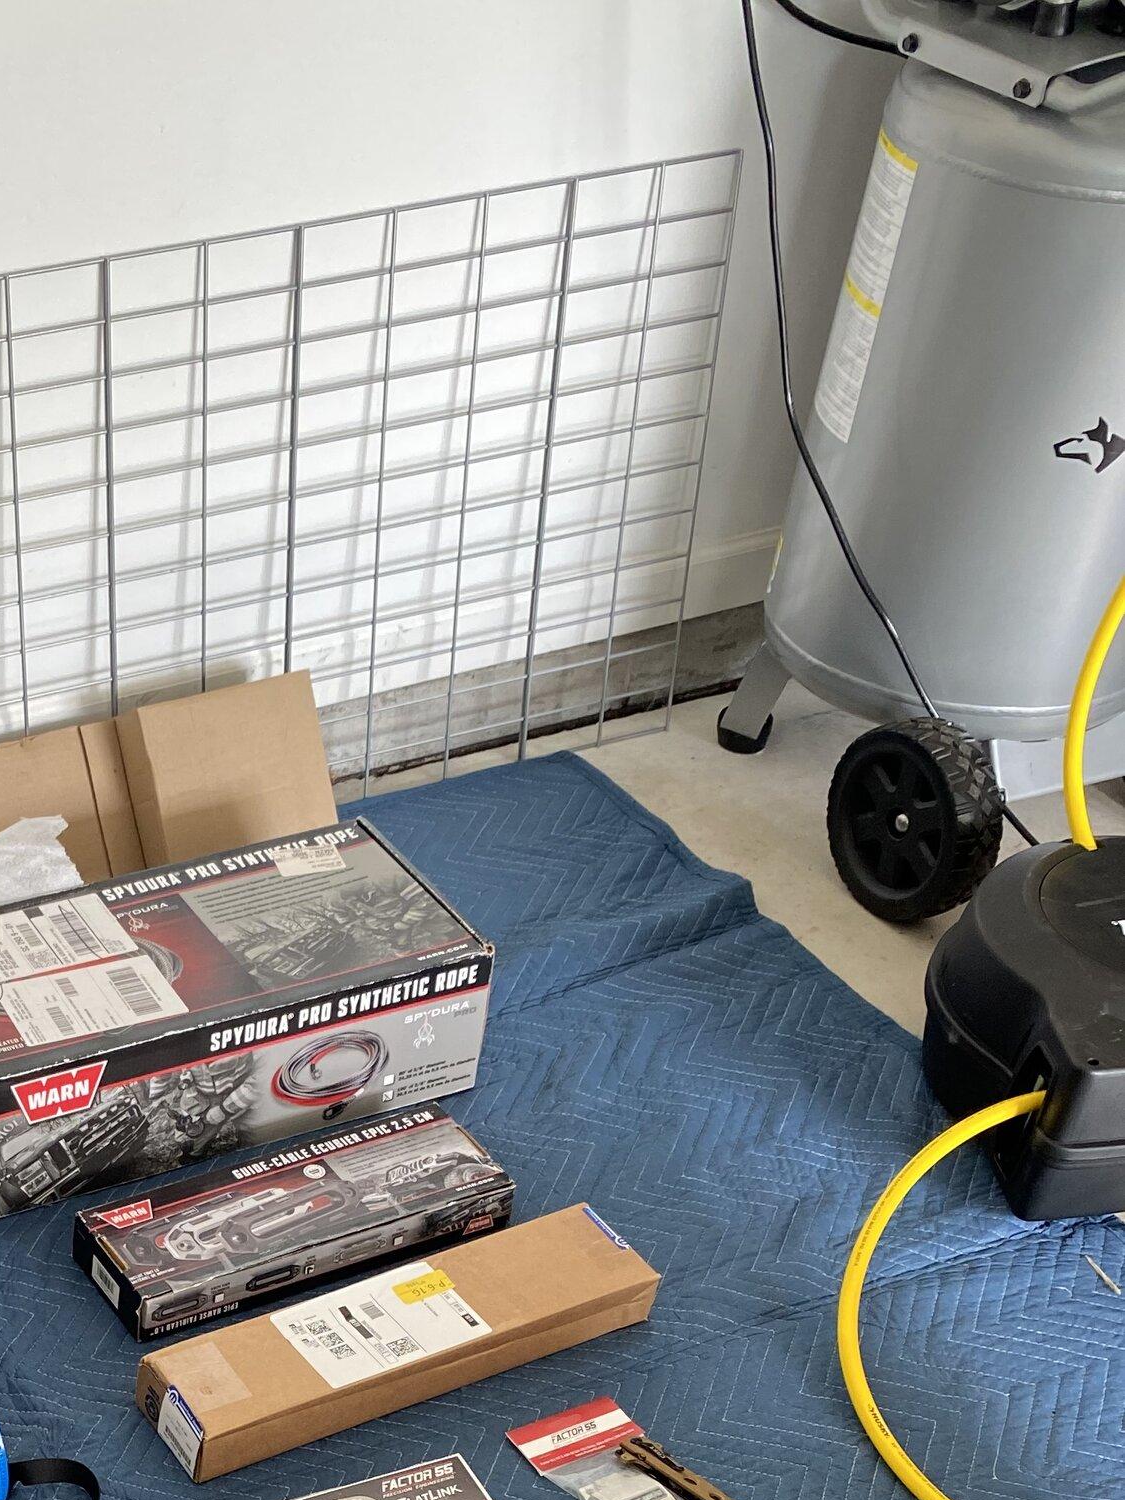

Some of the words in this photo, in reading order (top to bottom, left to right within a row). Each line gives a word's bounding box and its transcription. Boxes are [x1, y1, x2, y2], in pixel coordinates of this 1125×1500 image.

[185, 860, 221, 881] PRO
[116, 902, 169, 920] PYDURA
[416, 943, 469, 961] WARN.COM
[298, 1002, 331, 1029] PRO
[337, 976, 430, 1017] SYNTHETIC
[435, 963, 479, 996] ROPE
[404, 1000, 470, 1024] SPYDURA
[28, 1079, 90, 1110] WARN
[361, 1124, 392, 1142] EPIC
[412, 1109, 435, 1124] CM
[110, 1207, 148, 1224] WARN
[198, 1306, 221, 1320] HAWSE
[222, 1301, 238, 1313] EPIC
[166, 1314, 196, 1331] FAIRLEAD
[552, 1426, 583, 1445] FACTOR
[584, 1420, 597, 1432] 55
[381, 1467, 431, 1493] FACTOR
[434, 1462, 454, 1476] 55
